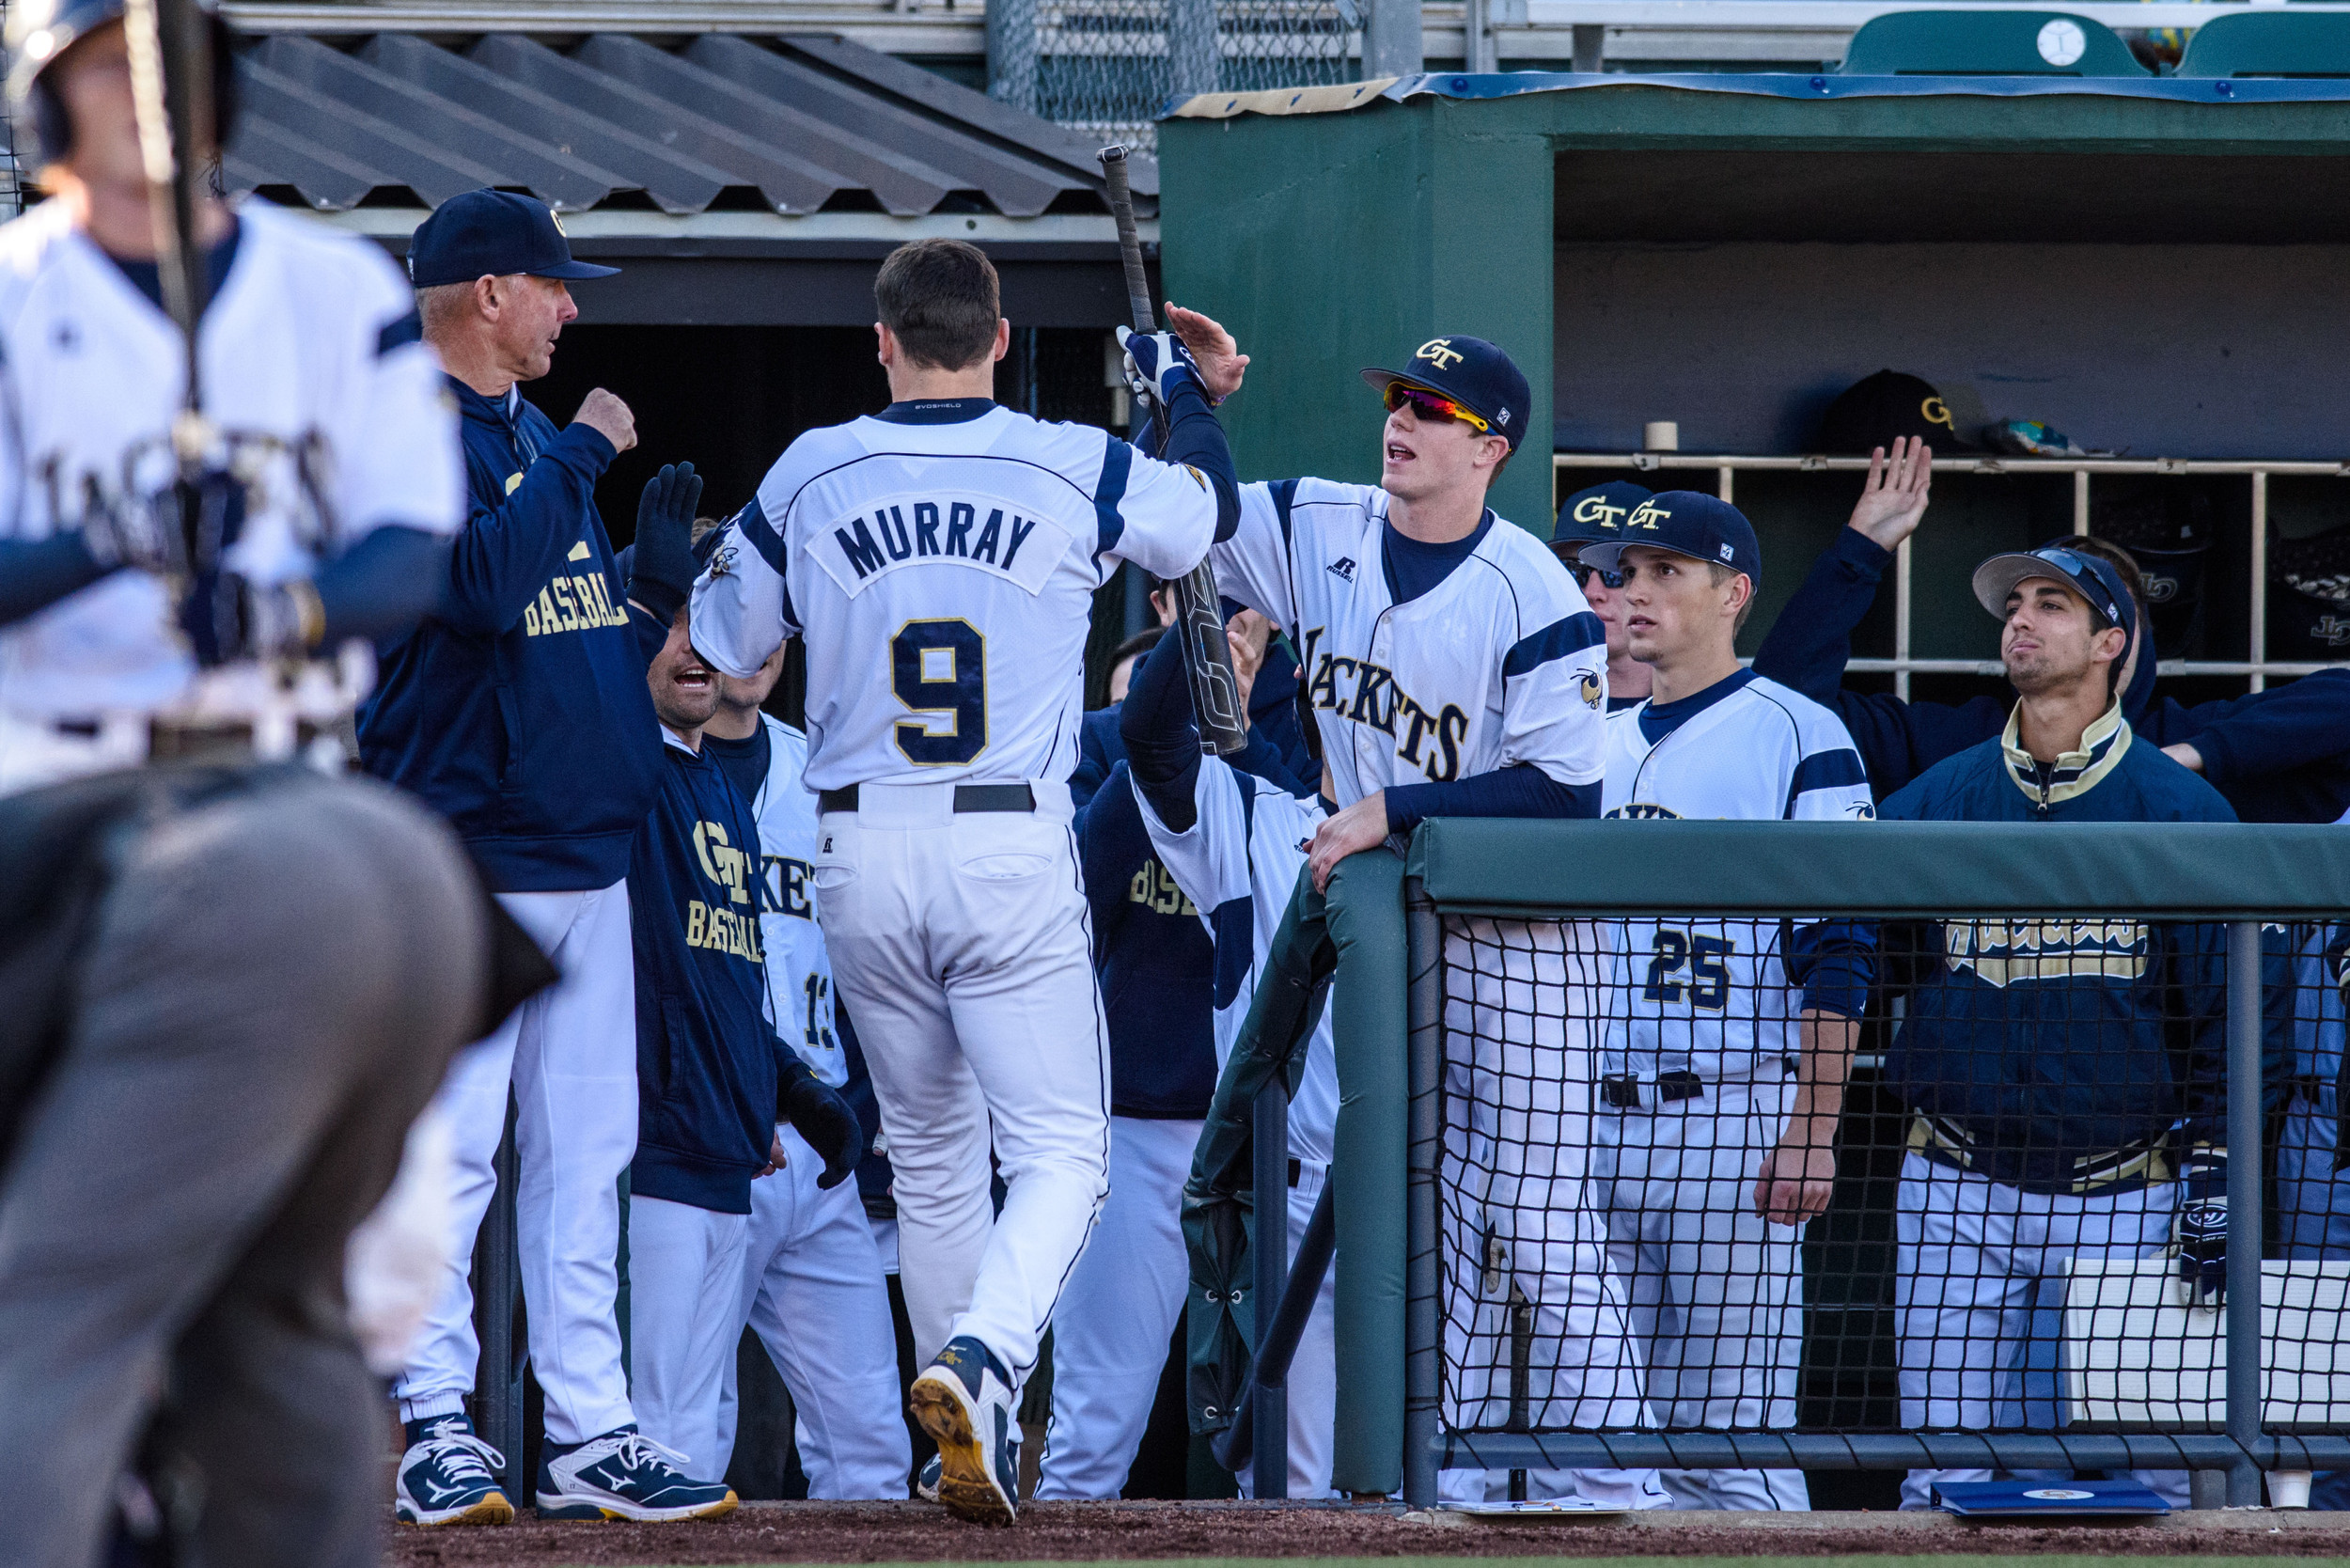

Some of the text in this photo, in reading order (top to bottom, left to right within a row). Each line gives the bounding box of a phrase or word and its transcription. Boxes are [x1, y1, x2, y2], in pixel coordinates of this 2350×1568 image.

[1416, 338, 1464, 370] GT
[1573, 494, 1626, 528] GT
[1627, 499, 1671, 529] GT
[834, 501, 1037, 580] MURRAY
[1325, 565, 1354, 584] RUSSELL
[889, 616, 990, 767] 9
[692, 820, 754, 905] GT
[1641, 927, 1737, 1012] 25
